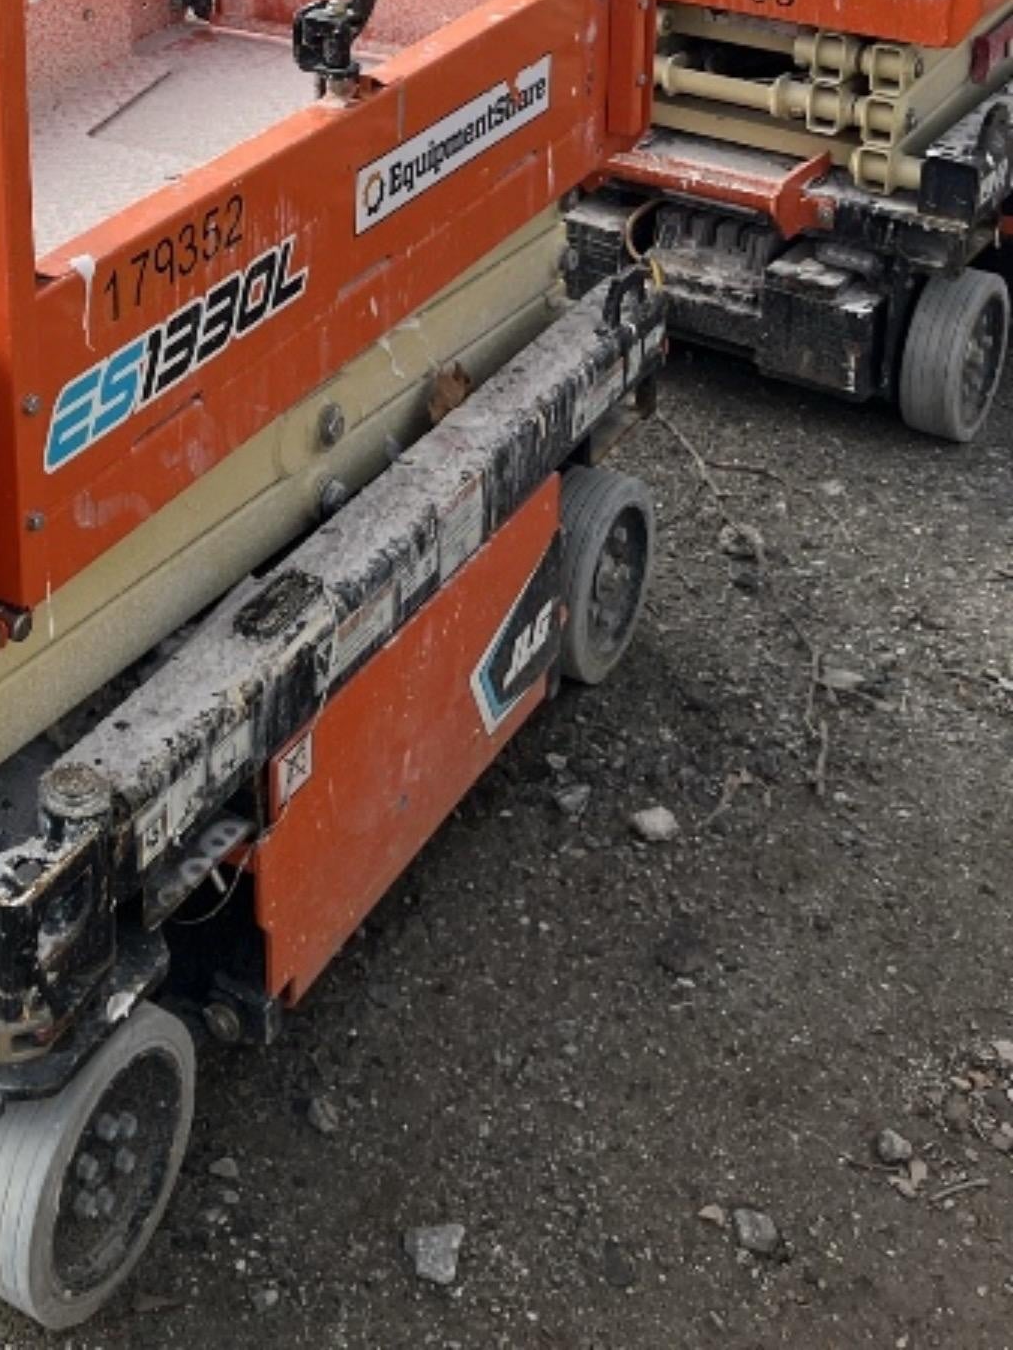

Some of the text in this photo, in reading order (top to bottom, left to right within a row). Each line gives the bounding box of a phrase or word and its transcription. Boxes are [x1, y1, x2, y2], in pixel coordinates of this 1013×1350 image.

[388, 77, 546, 196] EquipmentShare
[104, 194, 244, 321] 179352
[44, 233, 308, 475] ES1330L
[502, 599, 553, 691] JLG
